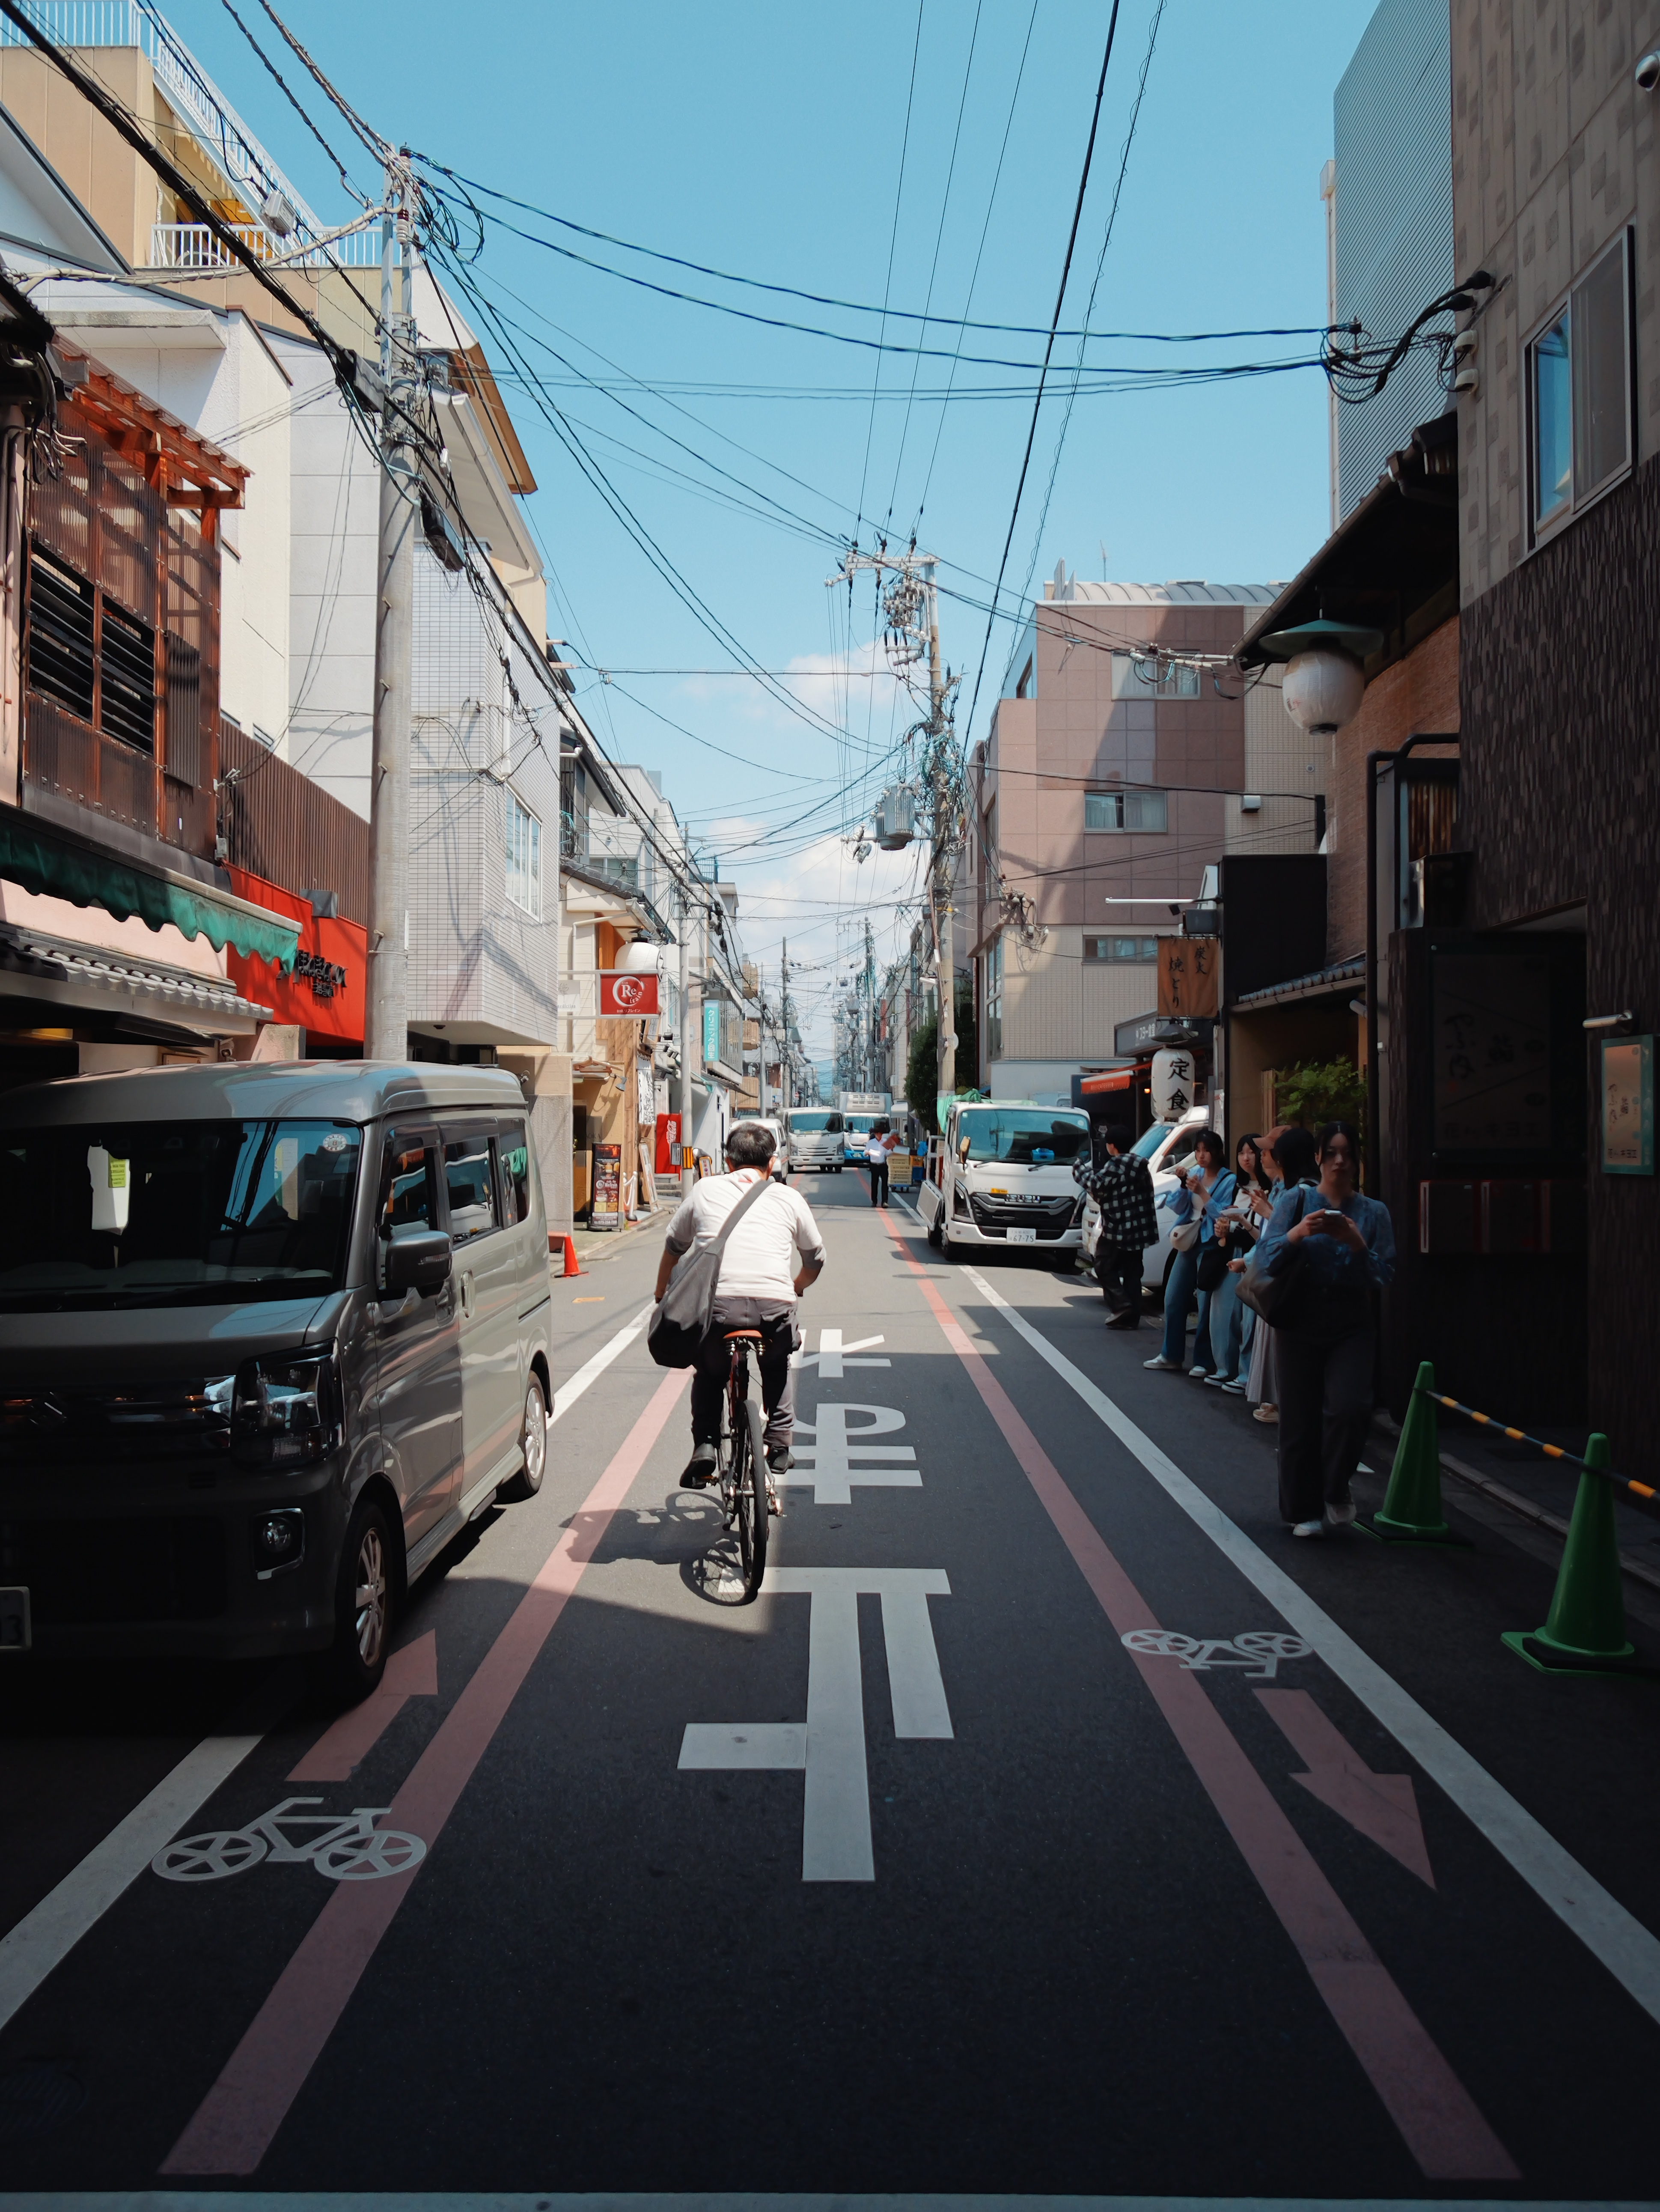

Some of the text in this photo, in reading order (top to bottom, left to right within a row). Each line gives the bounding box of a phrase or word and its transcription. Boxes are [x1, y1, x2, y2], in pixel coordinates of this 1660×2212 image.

[1169, 956, 1184, 1008] 焼とり
[621, 984, 637, 997] Re
[630, 991, 643, 1004] frain
[1166, 1058, 1190, 1111] 定食
[1006, 1194, 1041, 1203] ISUZU
